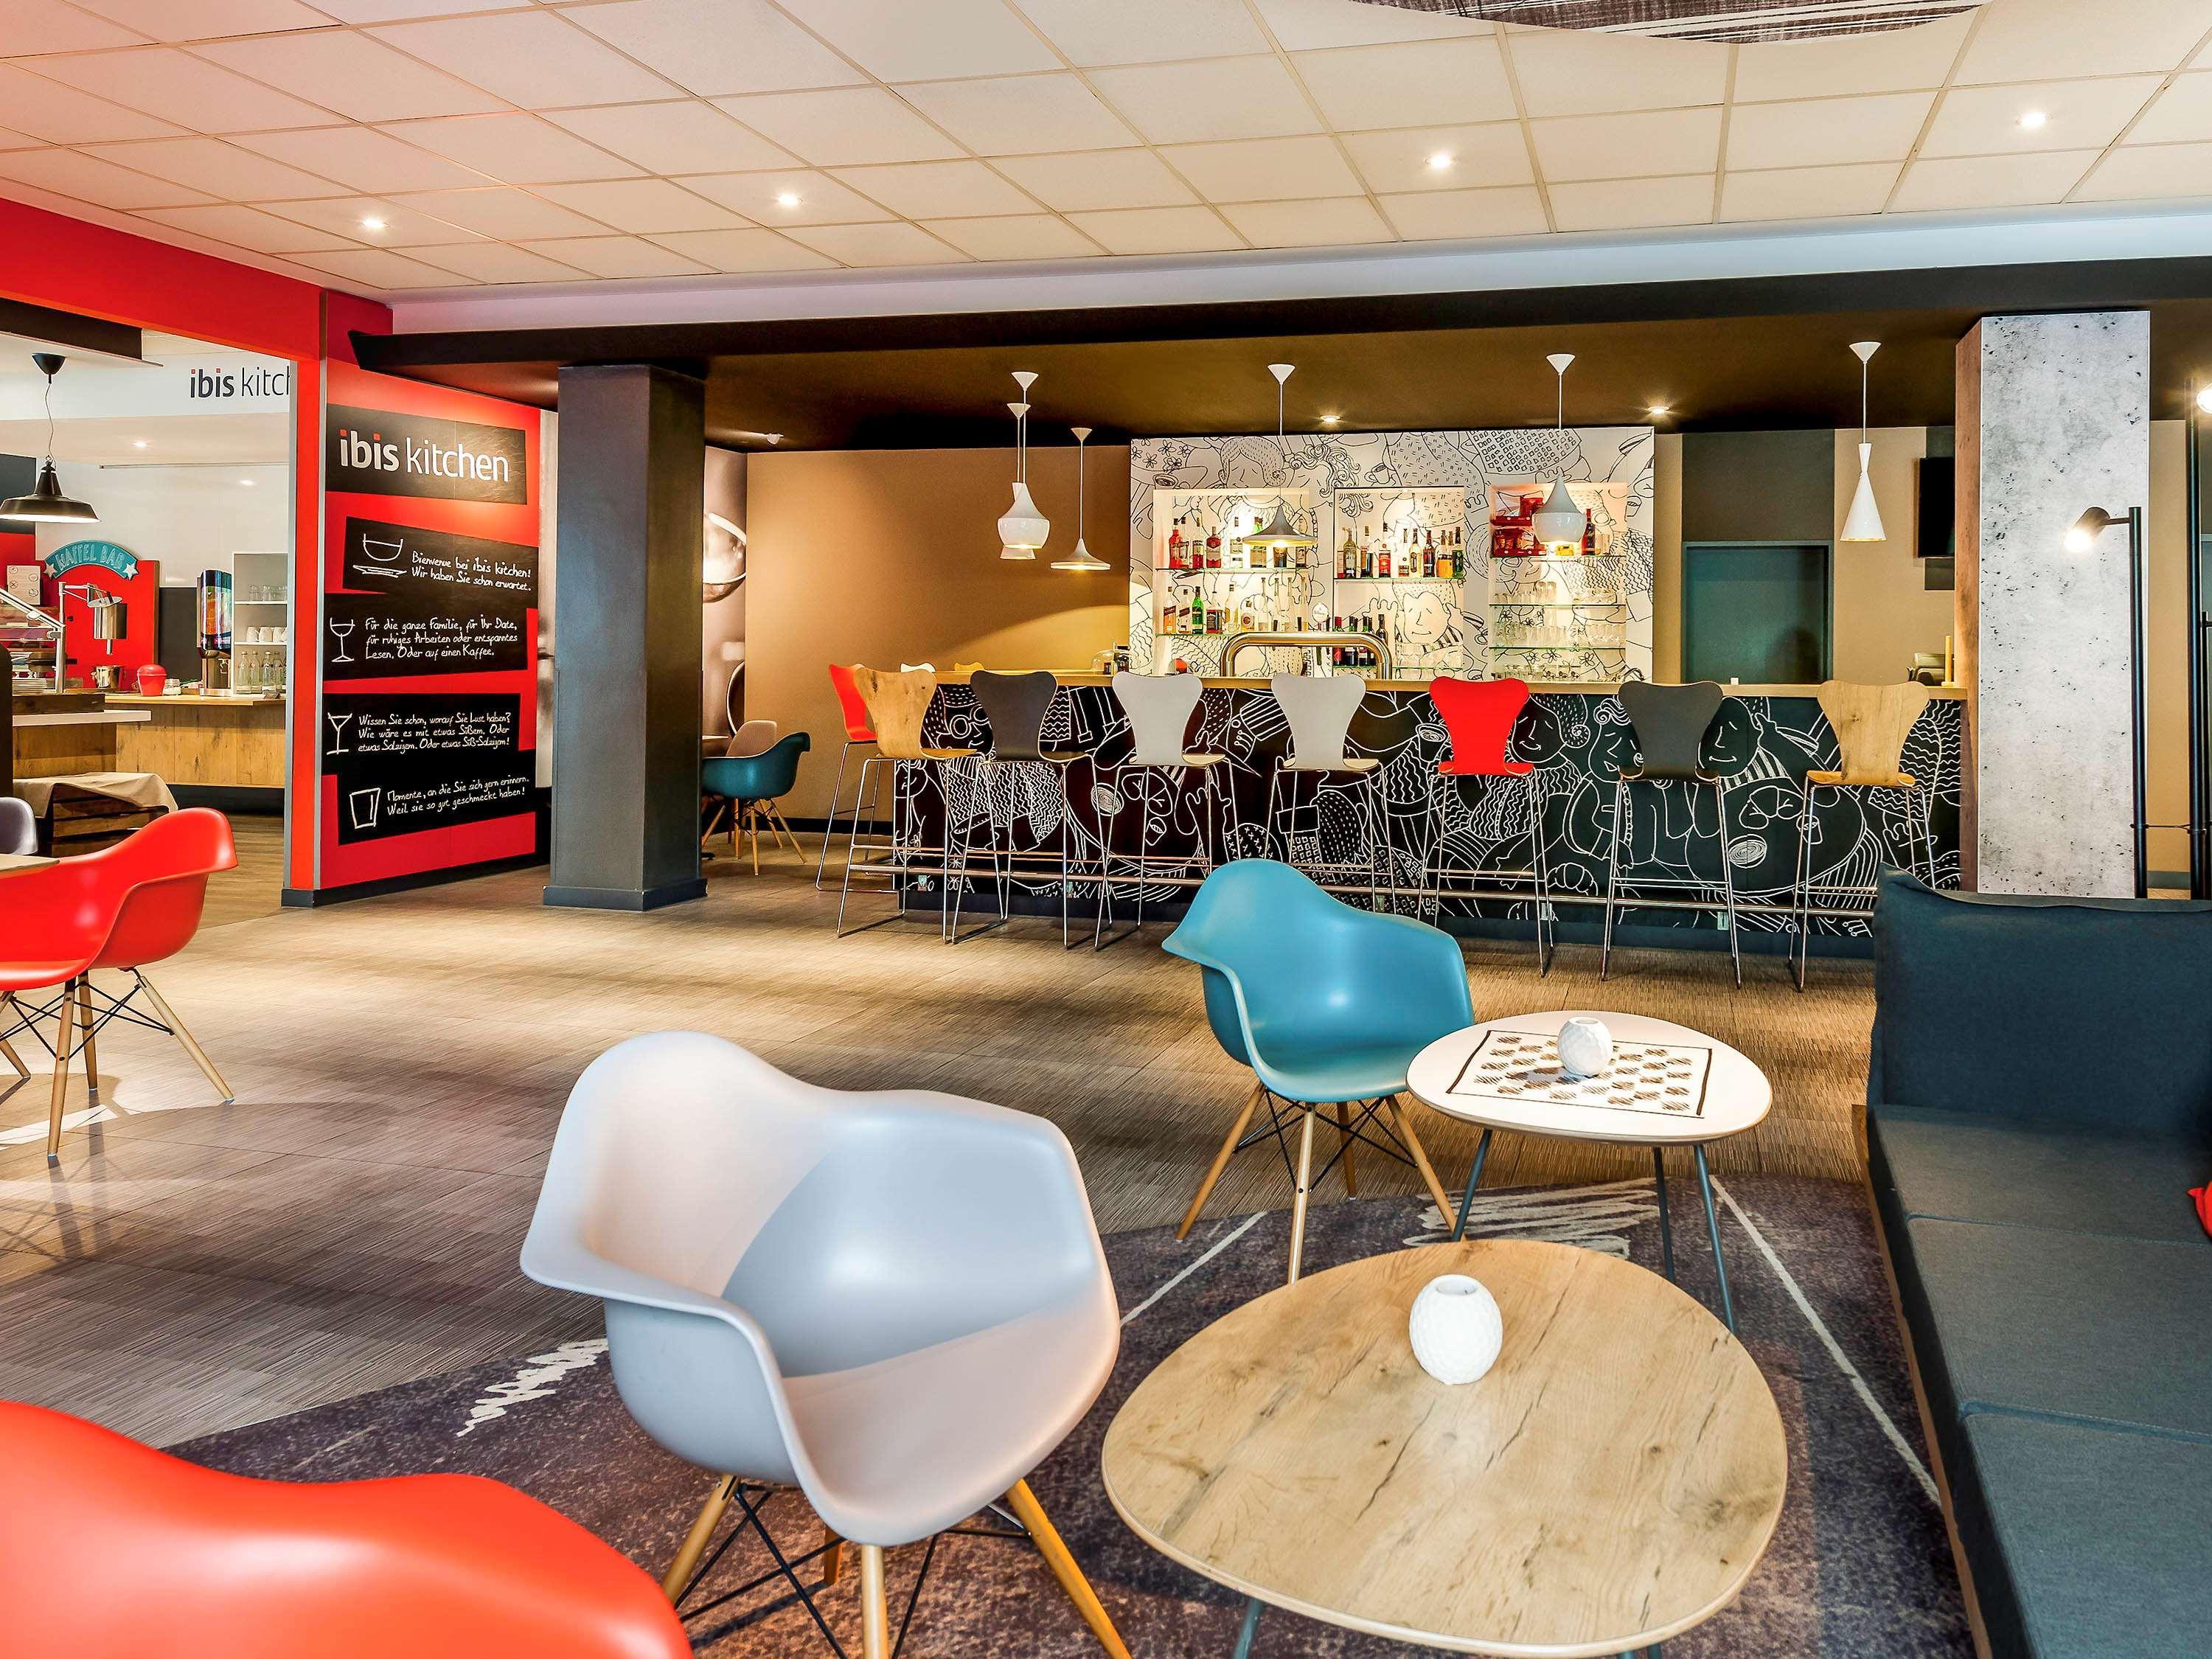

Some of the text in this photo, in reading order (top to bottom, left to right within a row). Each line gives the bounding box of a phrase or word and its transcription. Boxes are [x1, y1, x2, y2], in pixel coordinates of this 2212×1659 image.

[191, 369, 234, 397] ibis
[340, 429, 508, 482] ibis kitchen
[55, 544, 125, 571] WAFFEL BAR
[412, 551, 531, 577] Bienvenue bei ibis kitchen!
[412, 566, 531, 591] Wir haben Sie schon erwartet.
[365, 617, 380, 630] Für
[383, 619, 398, 630] die
[402, 622, 426, 634] ganze
[430, 617, 462, 630] Familie,
[466, 619, 477, 633] für
[495, 617, 517, 630] Date,
[366, 632, 518, 648] für ruhiges Arbeiten oder entspanntes
[366, 644, 494, 661] Lesen. Oder auf einen Kaffee.
[358, 727, 374, 738] Wie
[379, 728, 399, 737] wäre
[416, 726, 429, 737] mit
[490, 724, 509, 734] Oder
[359, 712, 511, 726] Wissen Sie schon, worauf Sie Lust haben?
[358, 743, 380, 751] etwas
[420, 738, 440, 749] Oder
[387, 790, 426, 801] Momente,
[439, 784, 451, 794] die
[453, 782, 466, 793] Sie
[469, 779, 482, 790] sich
[484, 781, 498, 792] gern
[501, 775, 529, 785] erinnern.
[387, 803, 408, 815] Weil
[411, 801, 423, 812] sie
[437, 800, 450, 812] gut
[452, 792, 497, 810] geschmeckt
[499, 787, 525, 798] haben!
